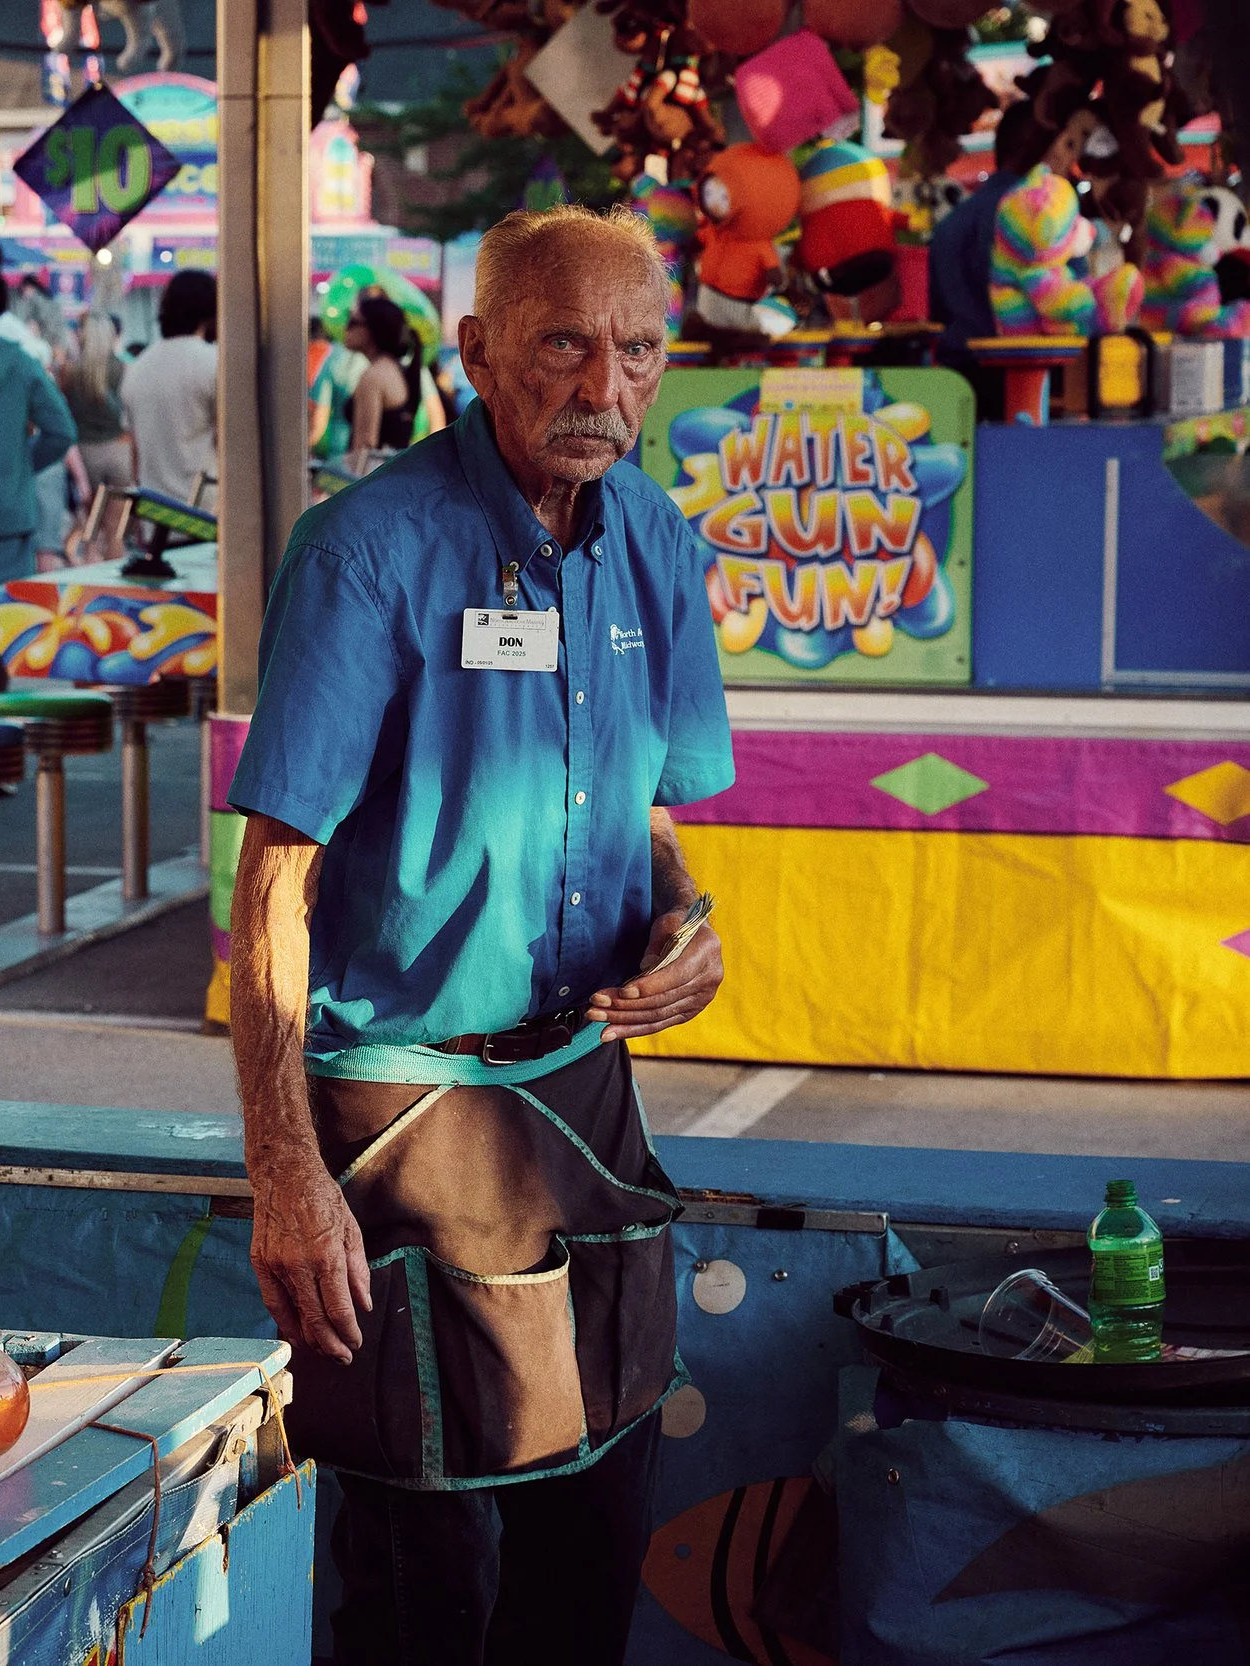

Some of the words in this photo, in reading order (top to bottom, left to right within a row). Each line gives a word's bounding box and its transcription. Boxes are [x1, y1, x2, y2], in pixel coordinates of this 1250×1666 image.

[46, 124, 152, 214] $10
[718, 412, 918, 492] WATER
[700, 487, 923, 559] GUN
[716, 553, 912, 632] FUN!
[498, 636, 524, 648] DON
